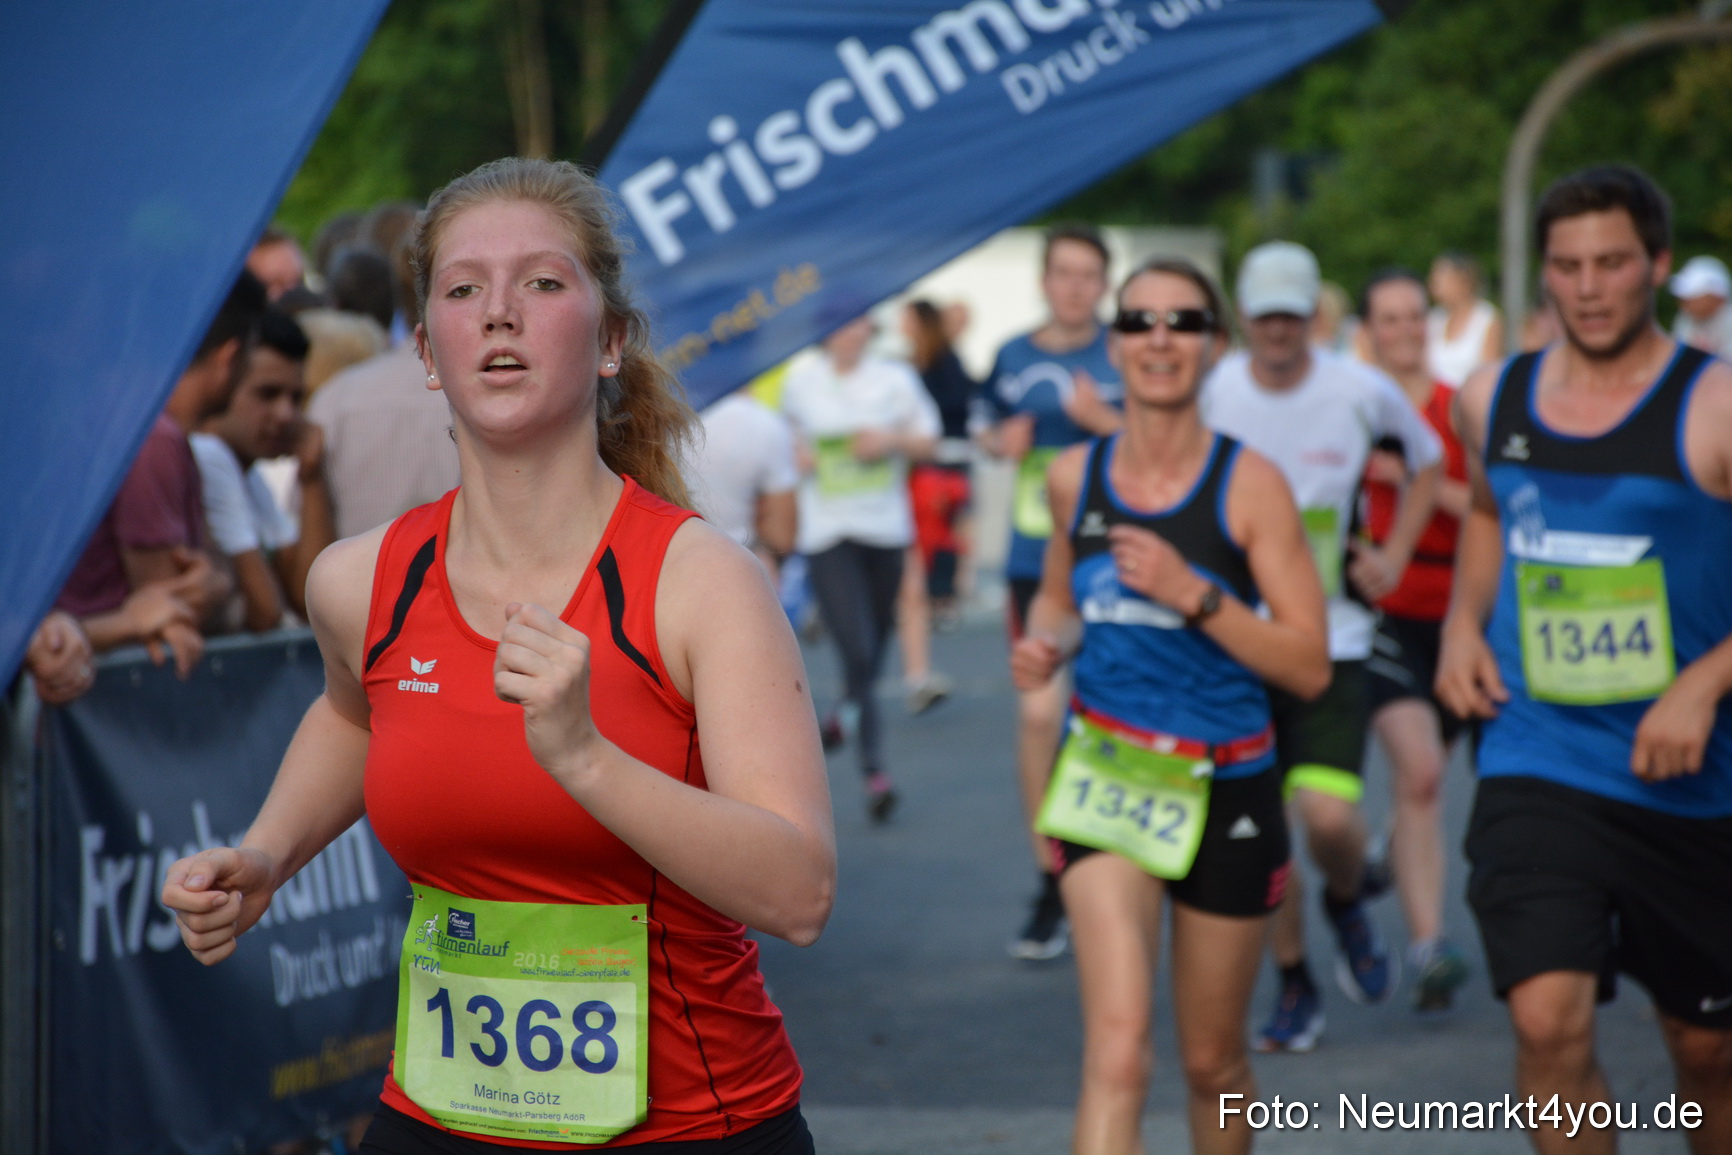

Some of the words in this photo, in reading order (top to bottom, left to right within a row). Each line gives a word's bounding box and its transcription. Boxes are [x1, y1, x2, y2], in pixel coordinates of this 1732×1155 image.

[1000, 8, 1149, 115] Druck
[617, 0, 1122, 266] Frischma
[1538, 615, 1654, 665] 1344
[398, 678, 439, 694] erima
[1072, 778, 1188, 846] 1342
[436, 930, 511, 957] firmenlauf
[513, 952, 560, 970] 2016
[427, 987, 619, 1074] 1368
[474, 1083, 519, 1104] Marina
[523, 1090, 561, 1106] Götz
[449, 1100, 488, 1114] Sparkasse
[488, 1106, 561, 1122] Neumarkt-Parsberg
[563, 1112, 586, 1121] AdöR
[528, 1128, 560, 1136] Frischmann
